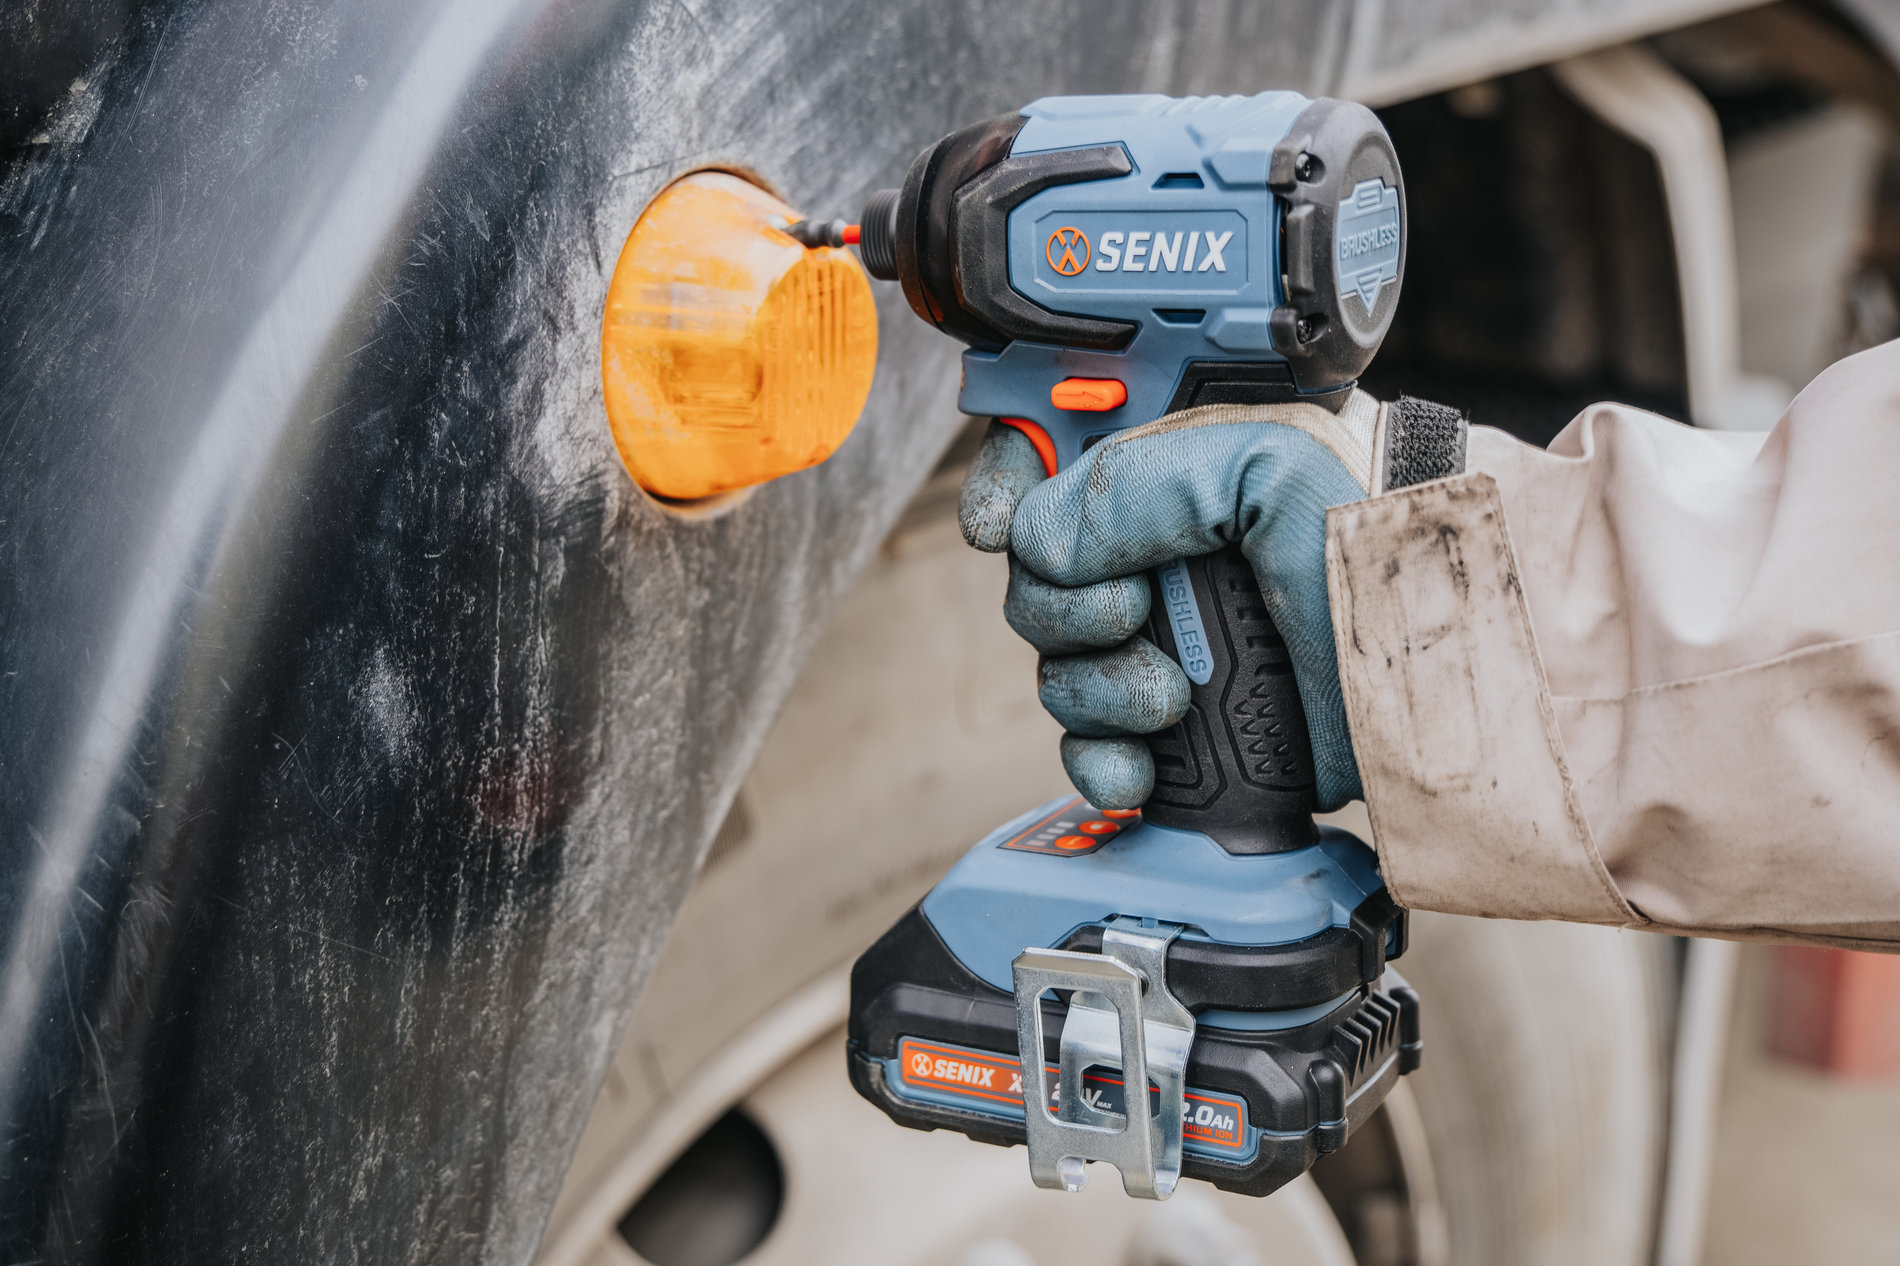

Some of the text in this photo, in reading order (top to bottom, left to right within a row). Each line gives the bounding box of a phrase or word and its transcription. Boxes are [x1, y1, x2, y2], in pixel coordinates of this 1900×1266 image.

[1095, 231, 1234, 272] SENIX
[1340, 222, 1398, 260] BRUSHLESS
[1163, 559, 1207, 674] RUSHLESS
[933, 1059, 995, 1087] SENIX
[1096, 1101, 1112, 1109] MAX
[1215, 1129, 1233, 1141] ION
